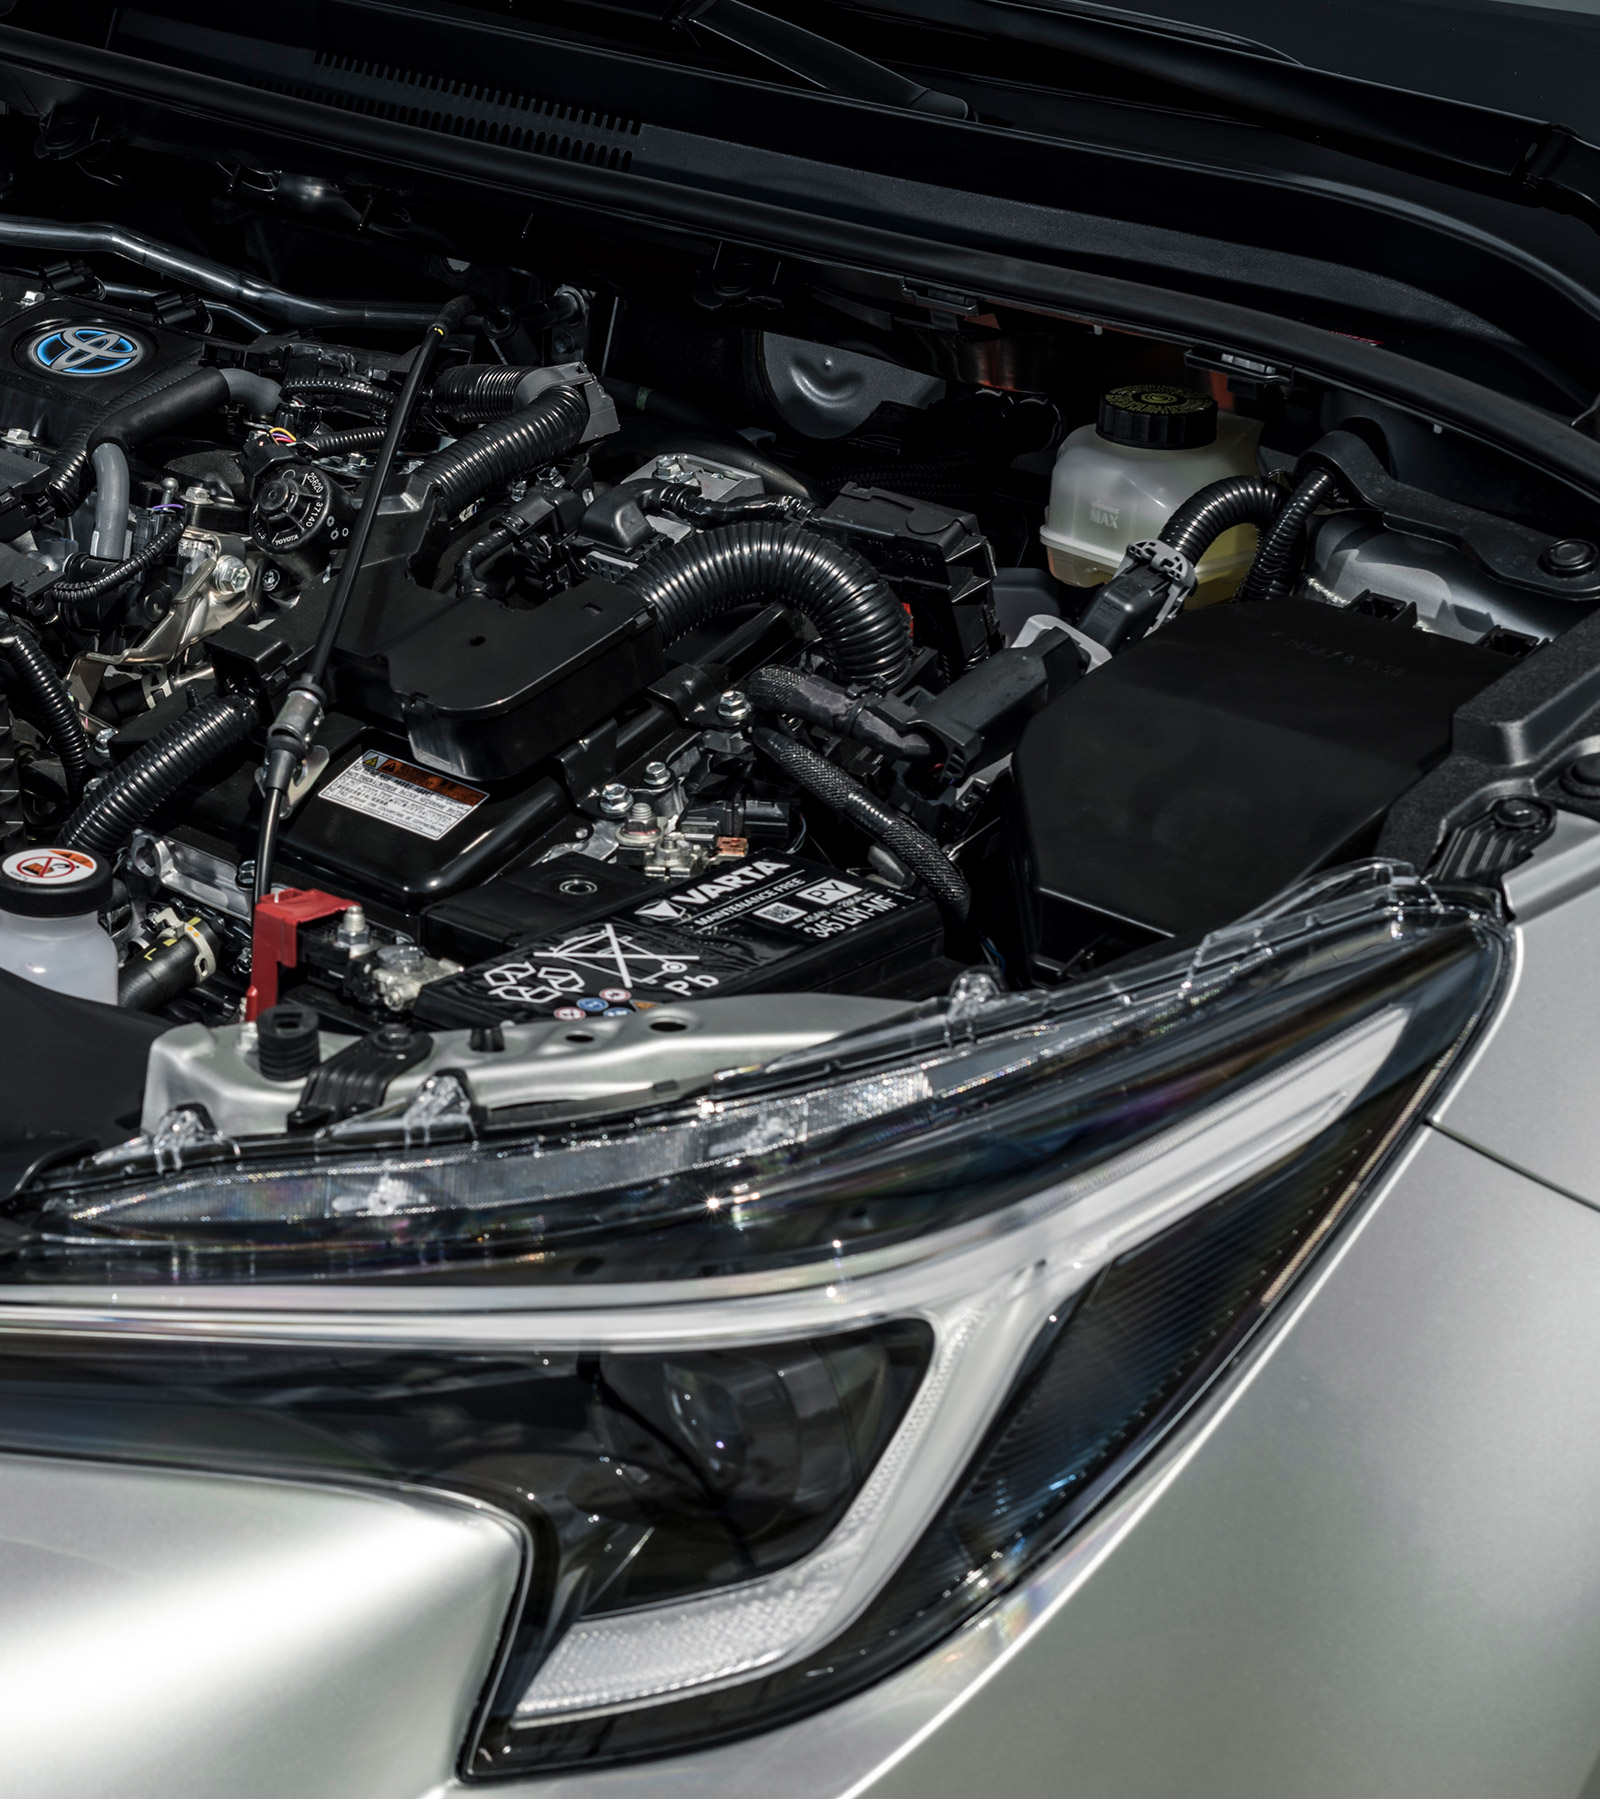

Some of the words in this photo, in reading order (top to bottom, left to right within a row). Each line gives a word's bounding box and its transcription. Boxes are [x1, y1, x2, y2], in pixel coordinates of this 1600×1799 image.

[307, 472, 324, 494] 25620
[305, 501, 324, 528] 37140
[1090, 509, 1118, 529] MAX
[275, 534, 299, 546] TOYOTA
[671, 861, 791, 905] VARTA
[806, 882, 848, 902] PY
[694, 889, 778, 927] MAINTENANCE
[776, 877, 806, 895] FREE
[664, 973, 720, 997] Pb
